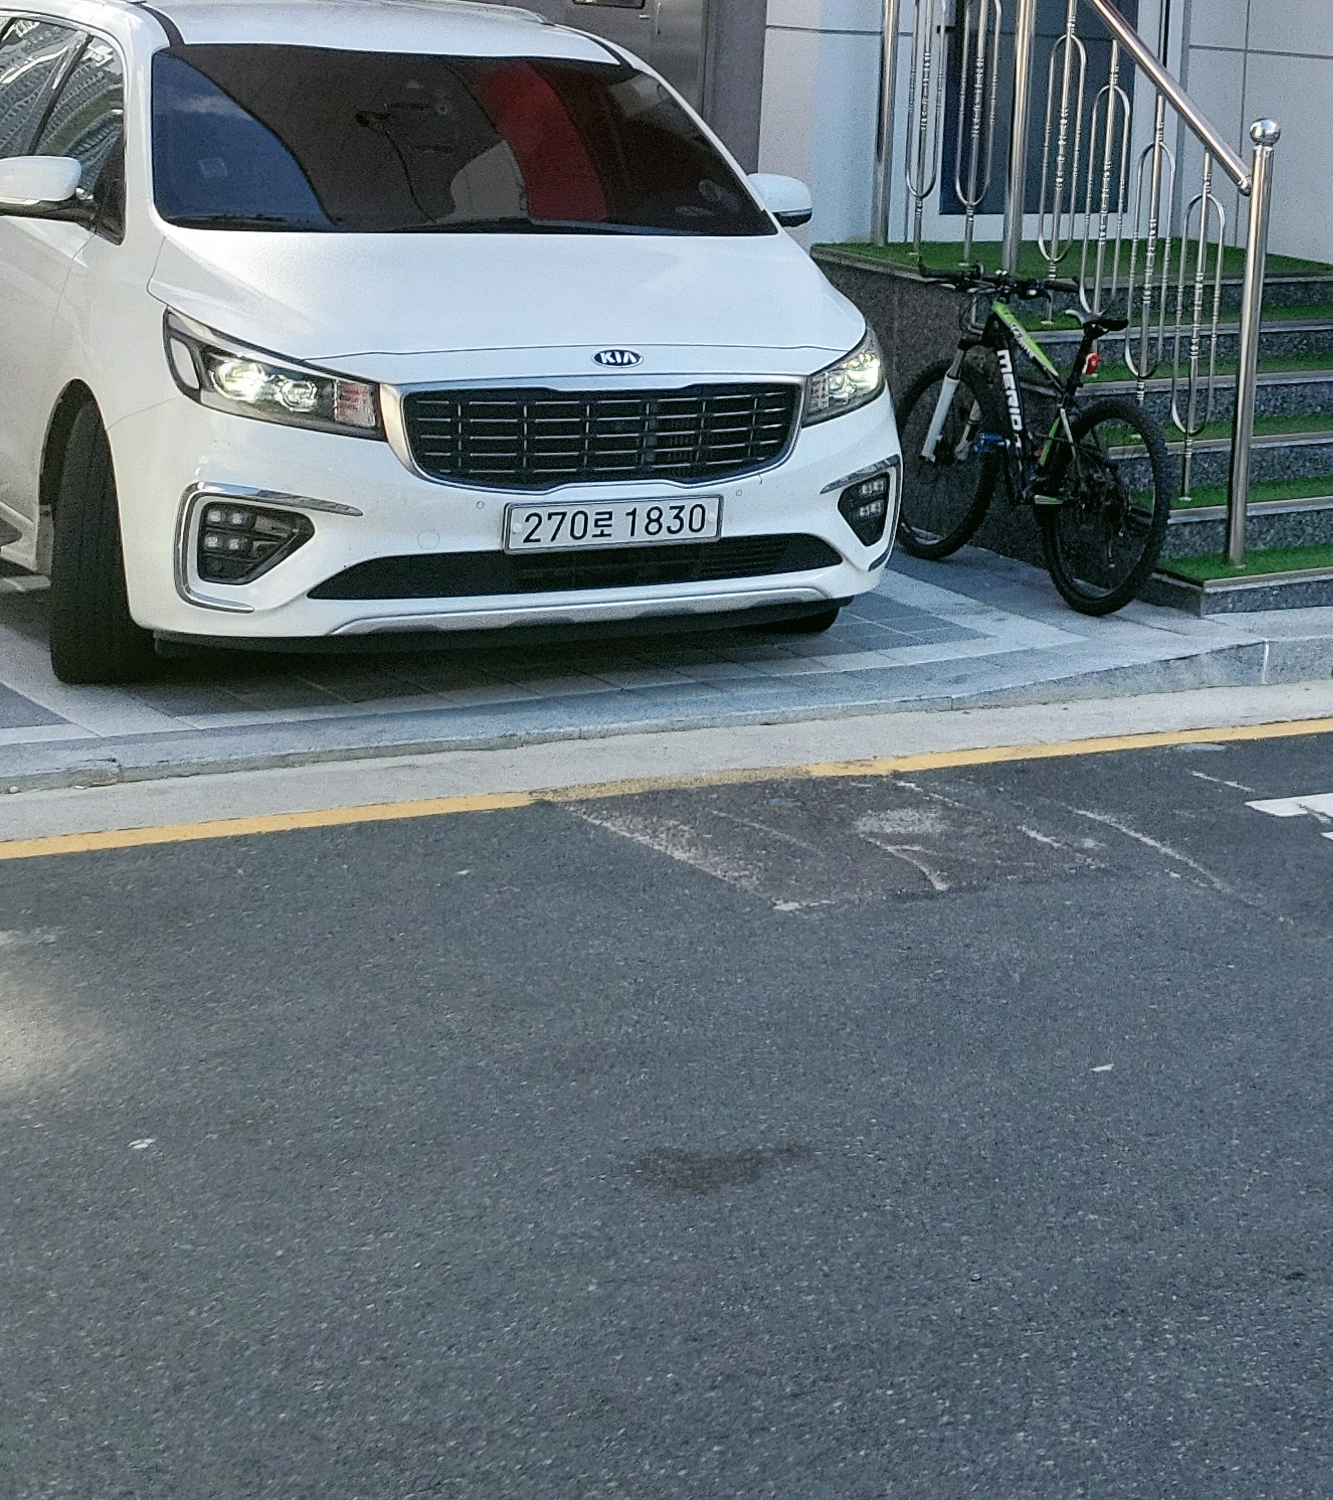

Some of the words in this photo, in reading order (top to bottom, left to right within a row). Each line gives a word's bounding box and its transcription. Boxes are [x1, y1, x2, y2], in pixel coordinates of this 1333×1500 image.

[600, 351, 638, 364] KIA
[522, 510, 614, 544] 270로
[625, 503, 707, 537] 1830
